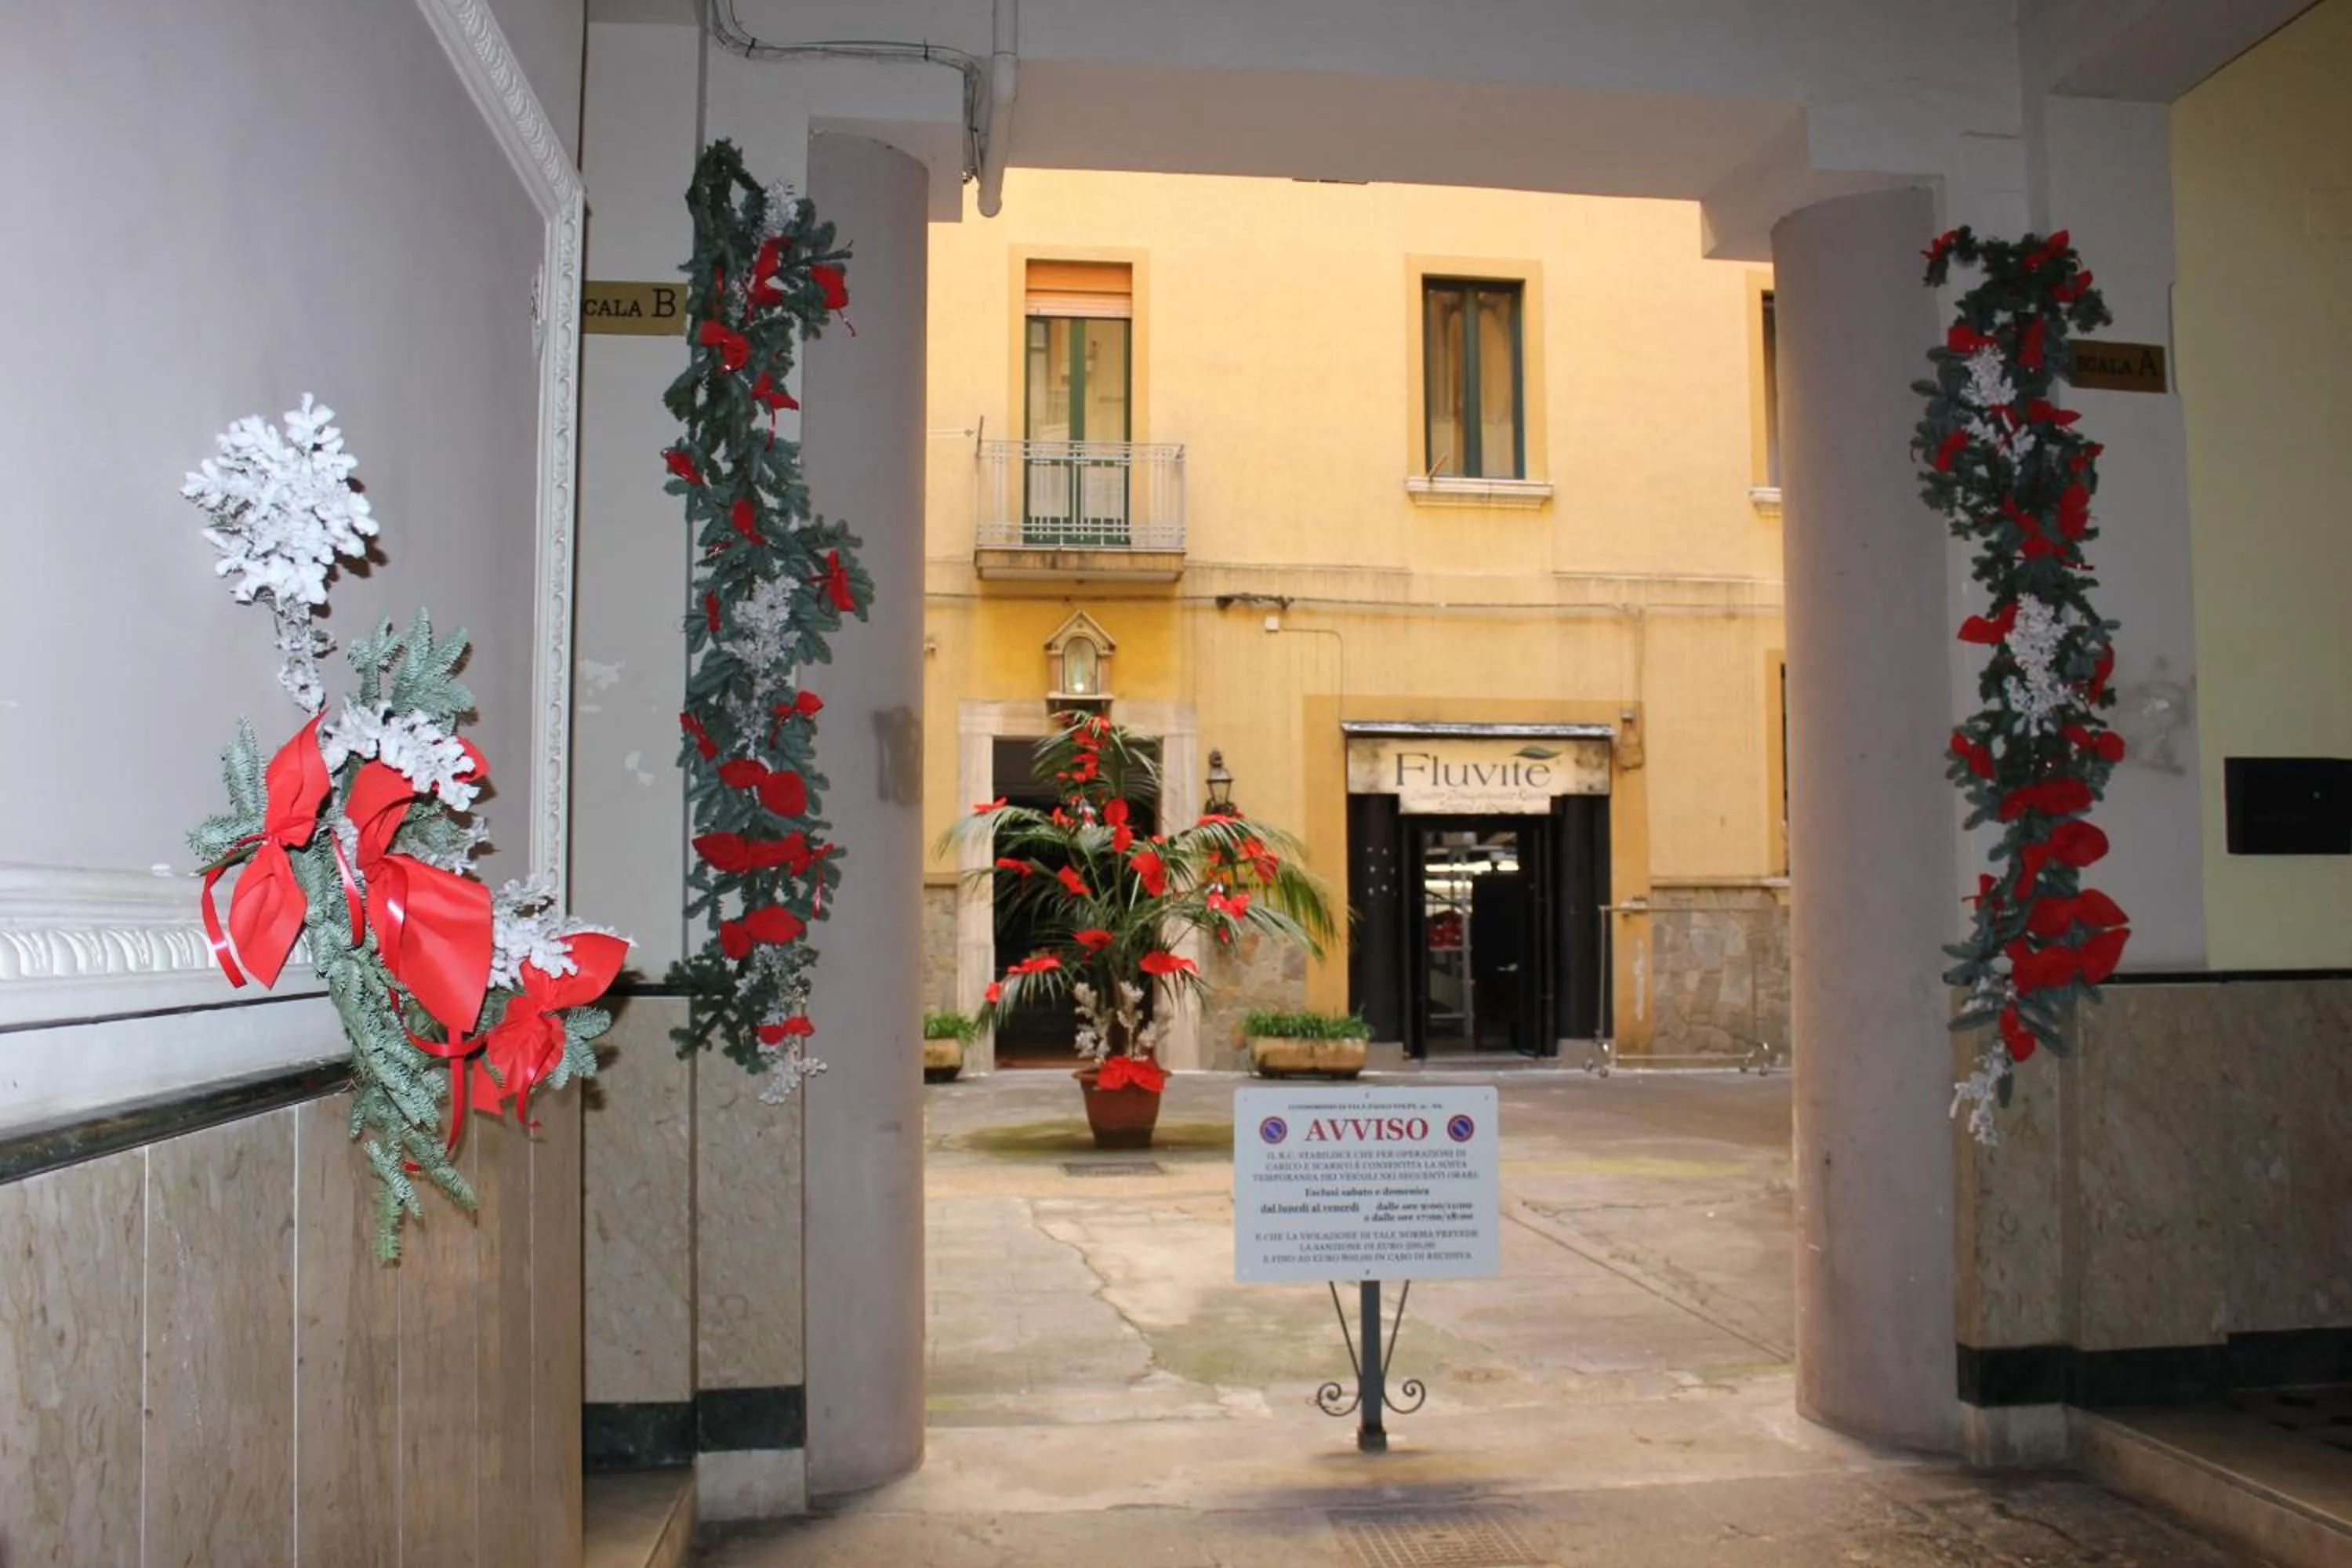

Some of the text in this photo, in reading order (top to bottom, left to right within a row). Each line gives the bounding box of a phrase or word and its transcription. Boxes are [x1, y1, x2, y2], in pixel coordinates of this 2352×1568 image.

[583, 289, 677, 318] CALA B
[2139, 350, 2158, 377] A
[1305, 1117, 1428, 1142] AVVISO
[1305, 1188, 1338, 1196] Esclusi
[1341, 1187, 1372, 1196] sabato
[1382, 1186, 1429, 1195] domenica
[1260, 1203, 1276, 1214] dal
